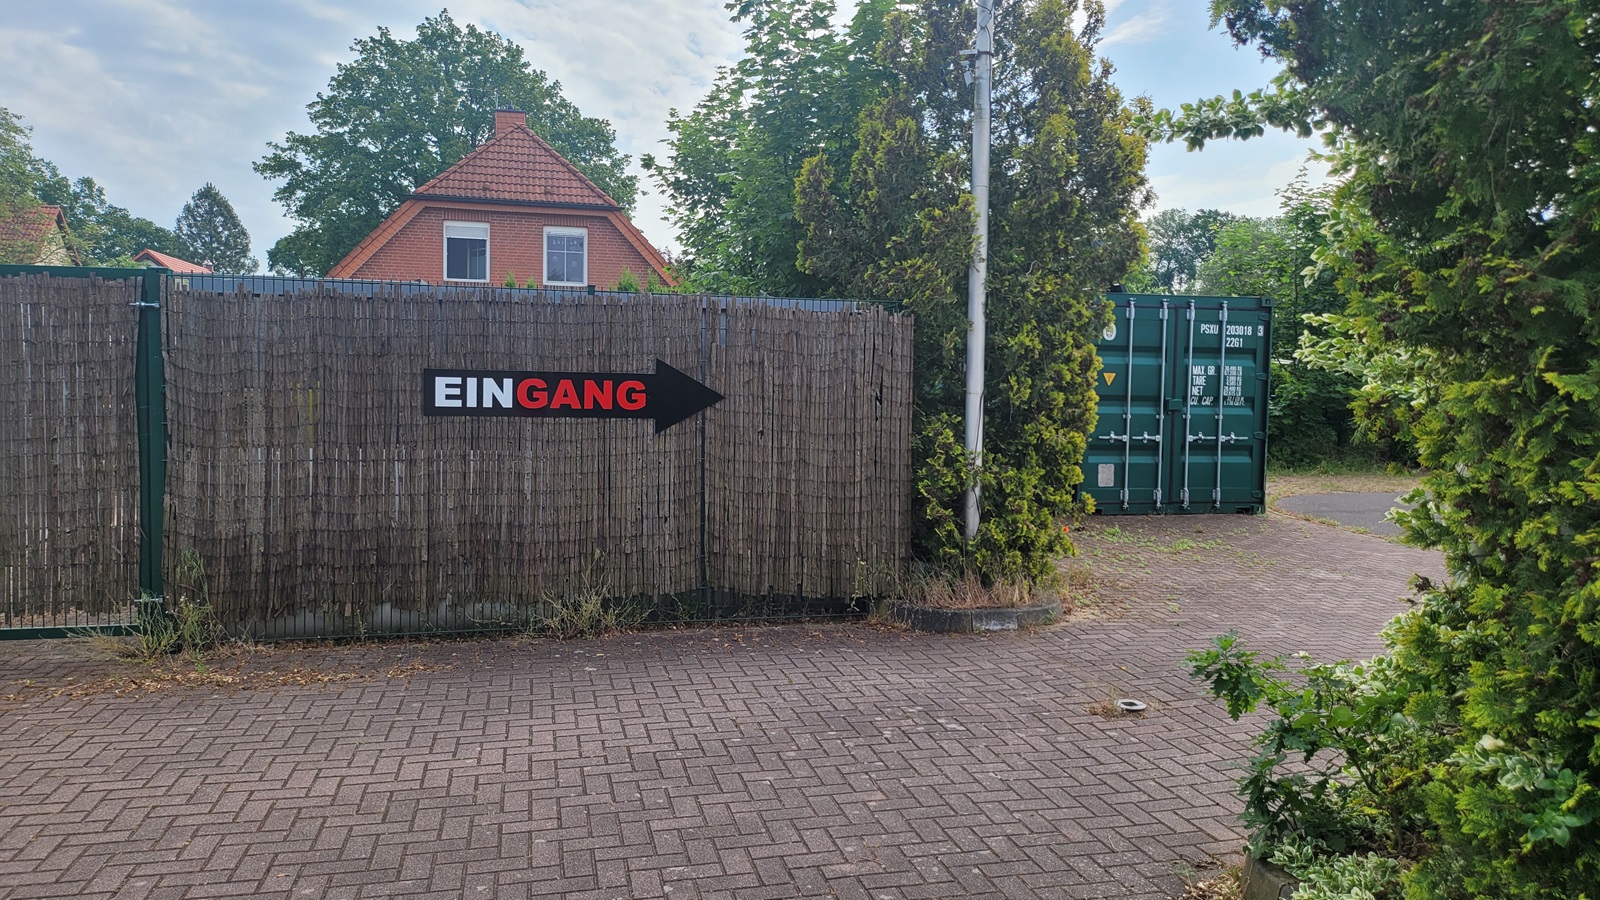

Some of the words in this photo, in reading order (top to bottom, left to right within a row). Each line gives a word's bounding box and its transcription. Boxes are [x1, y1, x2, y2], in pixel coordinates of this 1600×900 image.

[1200, 324, 1219, 334] PSXU
[1226, 325, 1252, 336] 203018
[1258, 325, 1264, 336] 3
[1226, 338, 1243, 348] 22G1
[1192, 365, 1207, 375] MAX.
[1207, 365, 1217, 375] GR.
[1192, 375, 1207, 386] TARE
[434, 376, 647, 411] EINGANG
[1191, 386, 1204, 396] NET
